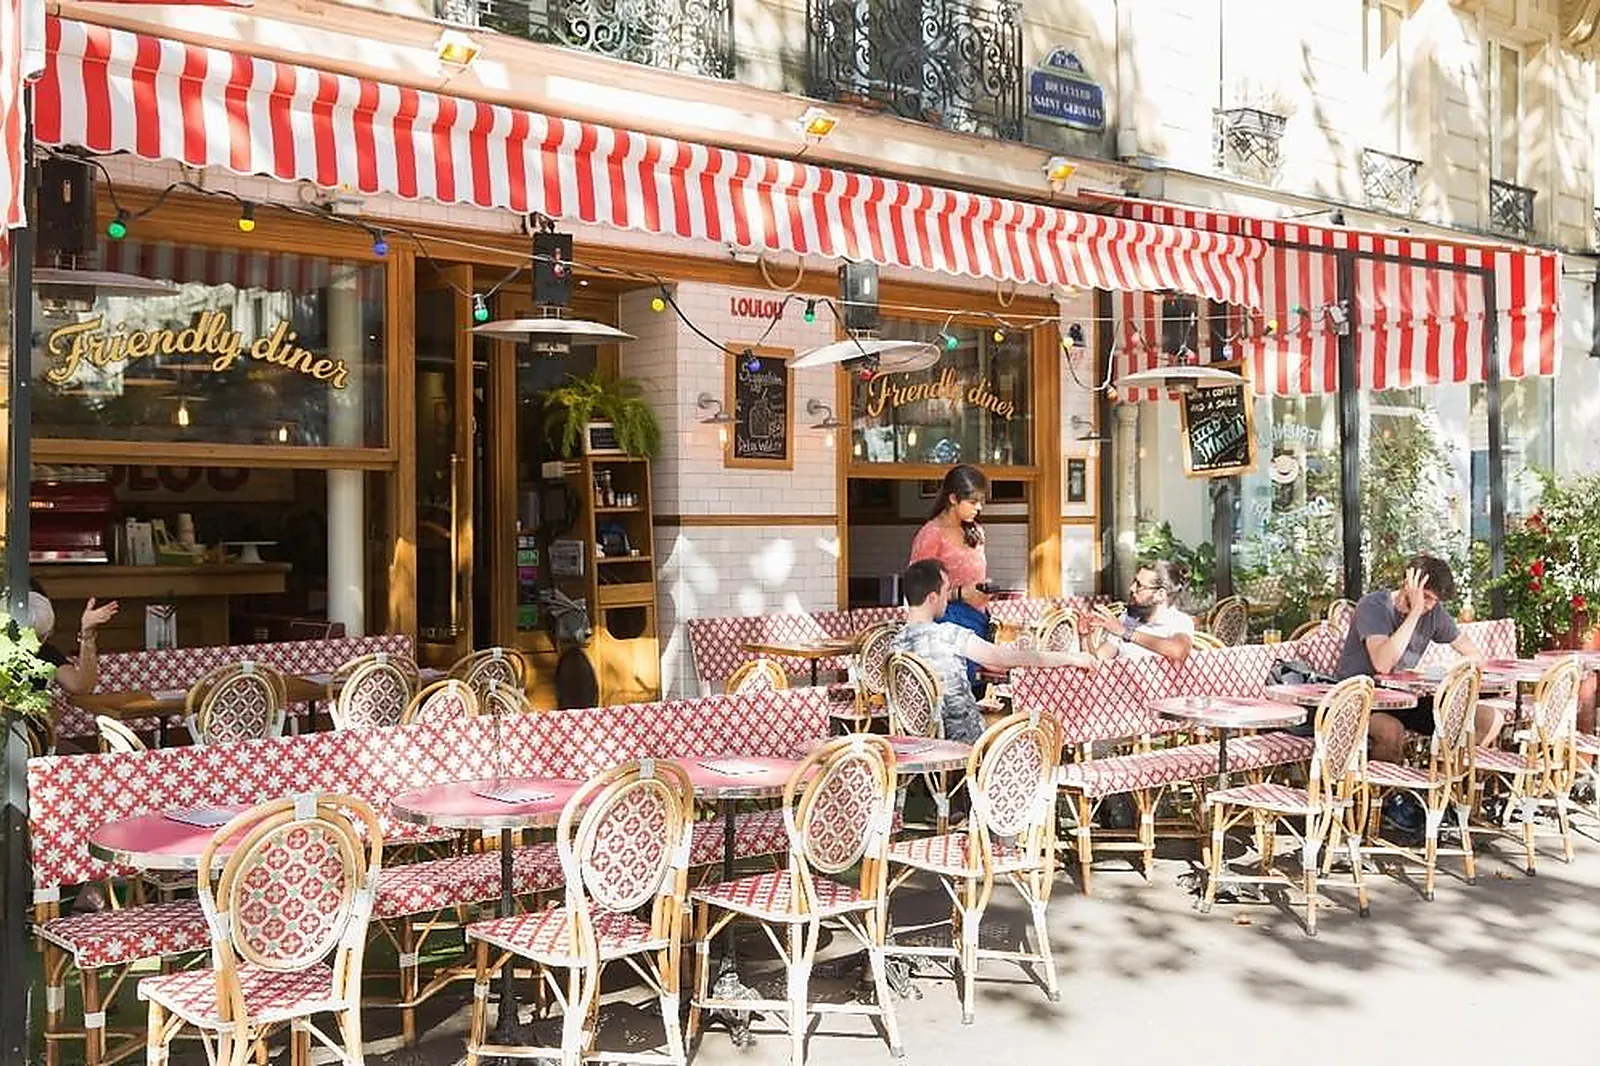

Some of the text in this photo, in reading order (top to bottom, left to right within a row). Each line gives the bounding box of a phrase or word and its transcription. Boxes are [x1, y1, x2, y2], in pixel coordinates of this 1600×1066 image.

[730, 297, 784, 320] LOULOU
[48, 310, 350, 390] Friendly diner
[867, 367, 1016, 422] Friendly diner
